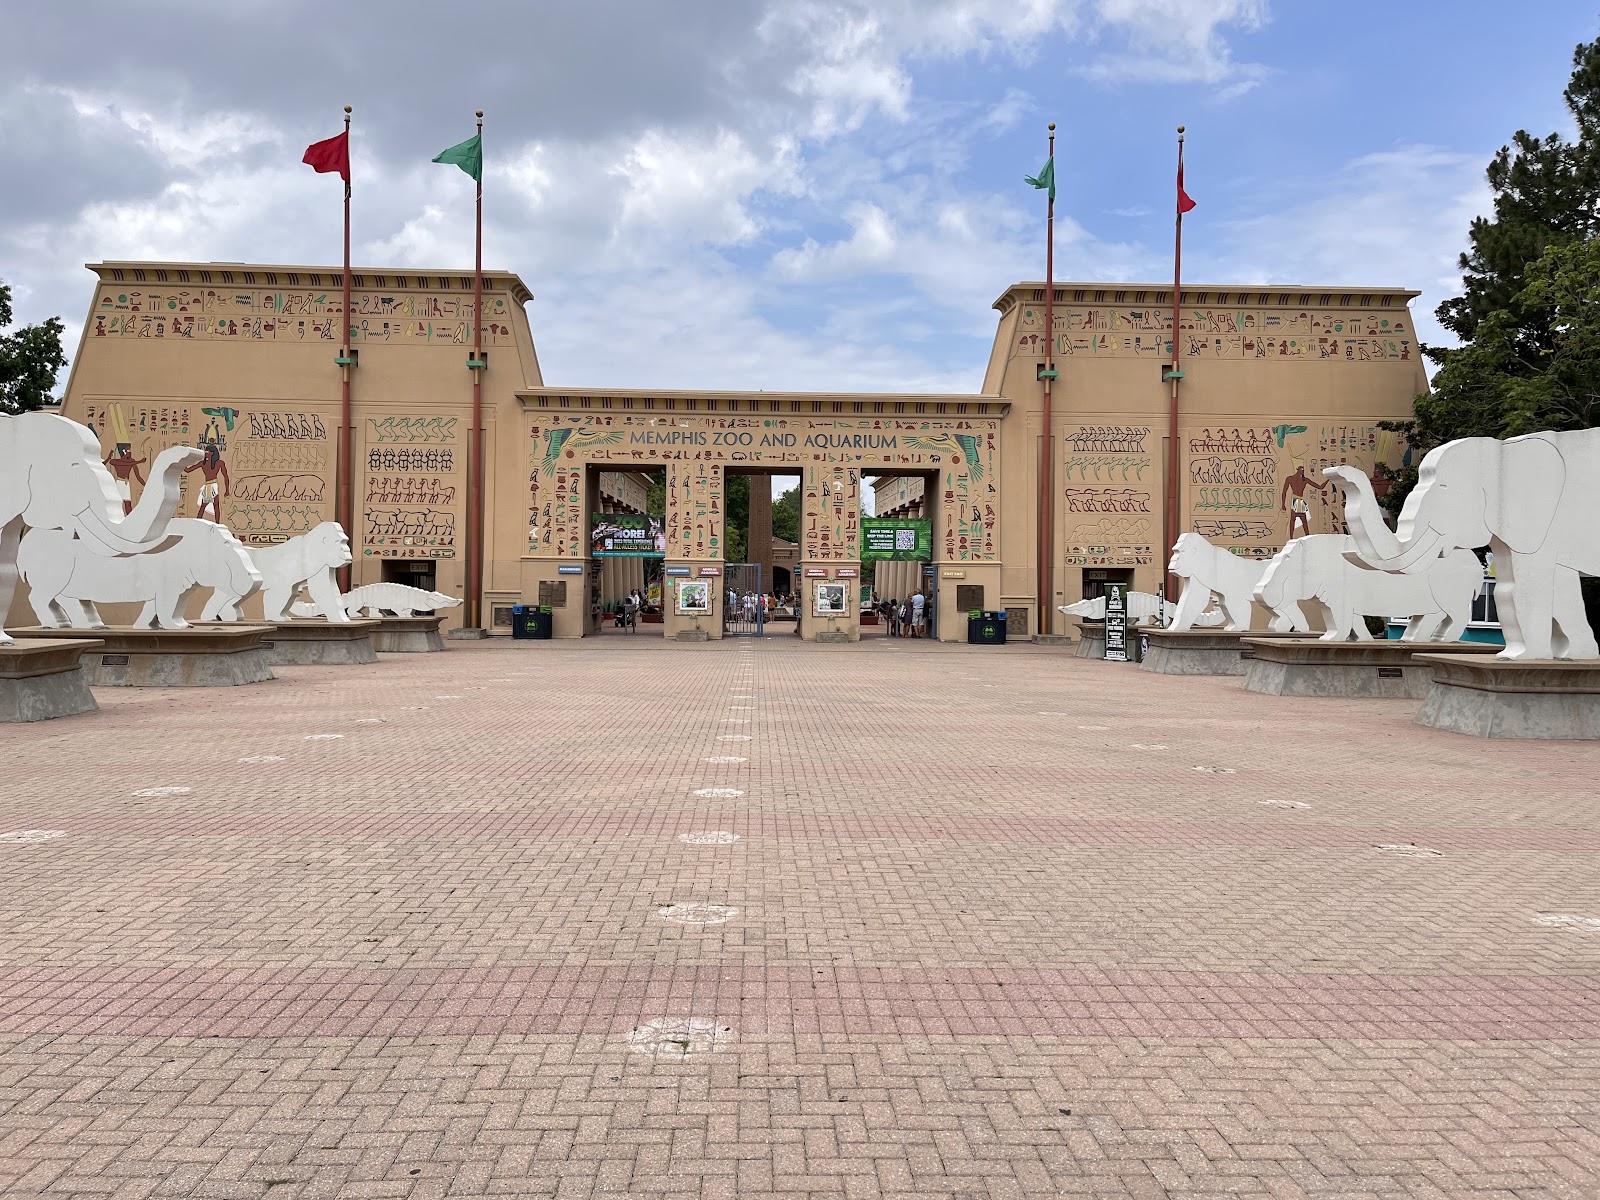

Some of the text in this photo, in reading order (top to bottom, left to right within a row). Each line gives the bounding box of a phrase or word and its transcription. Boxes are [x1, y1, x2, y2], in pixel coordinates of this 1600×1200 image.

[630, 431, 898, 450] MEMPHIS ZOO AND AQUARIUM
[615, 516, 645, 529] ZOO
